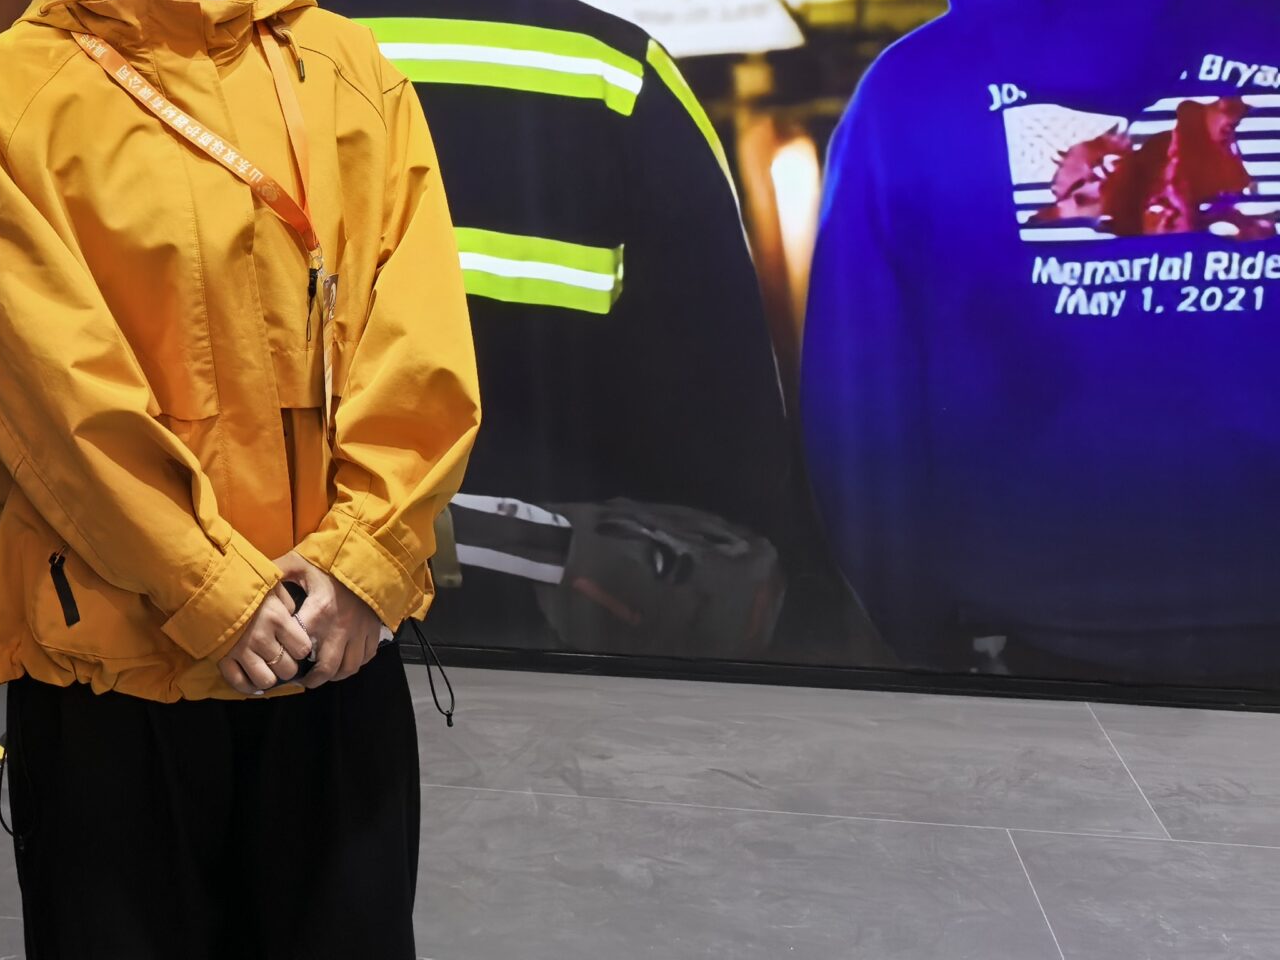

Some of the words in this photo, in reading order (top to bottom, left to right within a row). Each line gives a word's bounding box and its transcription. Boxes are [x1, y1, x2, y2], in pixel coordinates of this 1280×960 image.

[1032, 251, 1193, 286] Memorial
[1203, 250, 1280, 281] Ride
[1054, 286, 1127, 318] May
[1176, 285, 1265, 312] 2021
